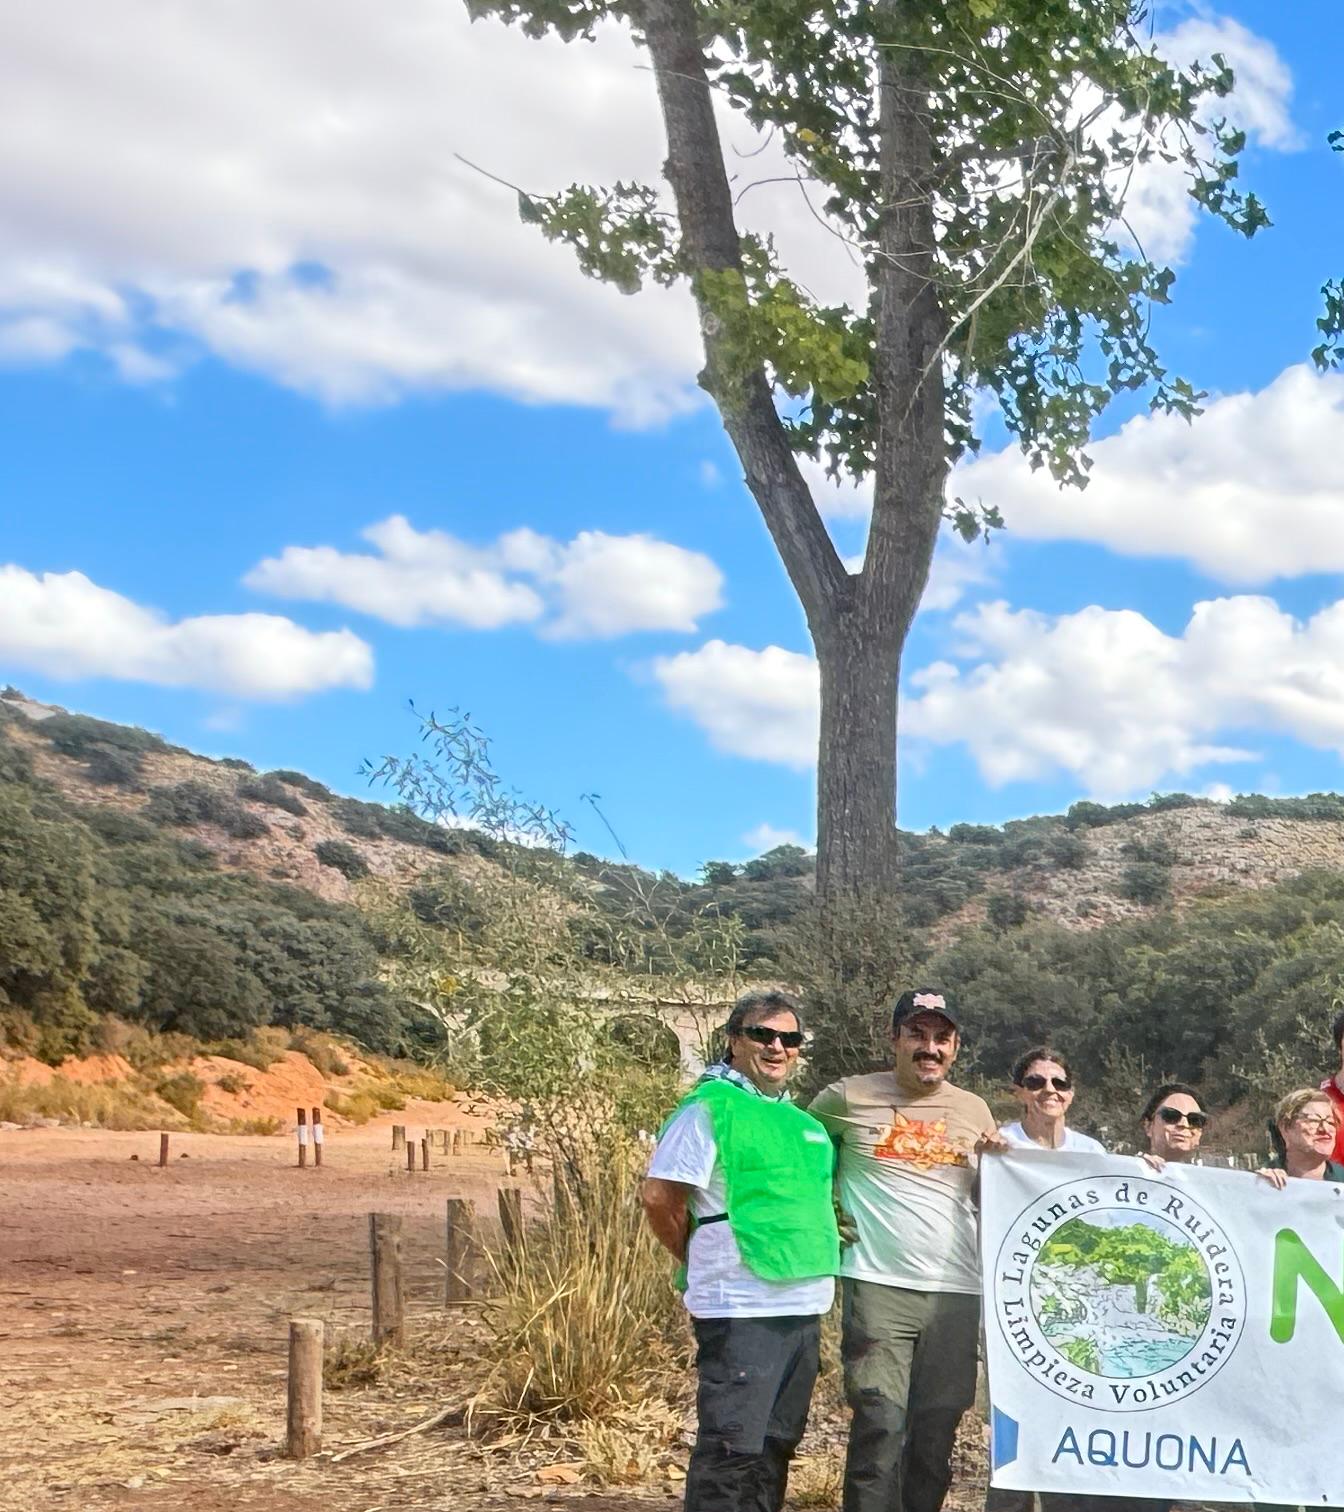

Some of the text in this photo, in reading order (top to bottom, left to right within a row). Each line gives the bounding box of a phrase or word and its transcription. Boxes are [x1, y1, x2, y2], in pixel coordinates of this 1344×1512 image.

[1002, 1182, 1235, 1306] Lagunas de Ruidera
[1002, 1298, 1237, 1405] Limpieza Voluntaria
[1051, 1426, 1253, 1476] AQUONA
